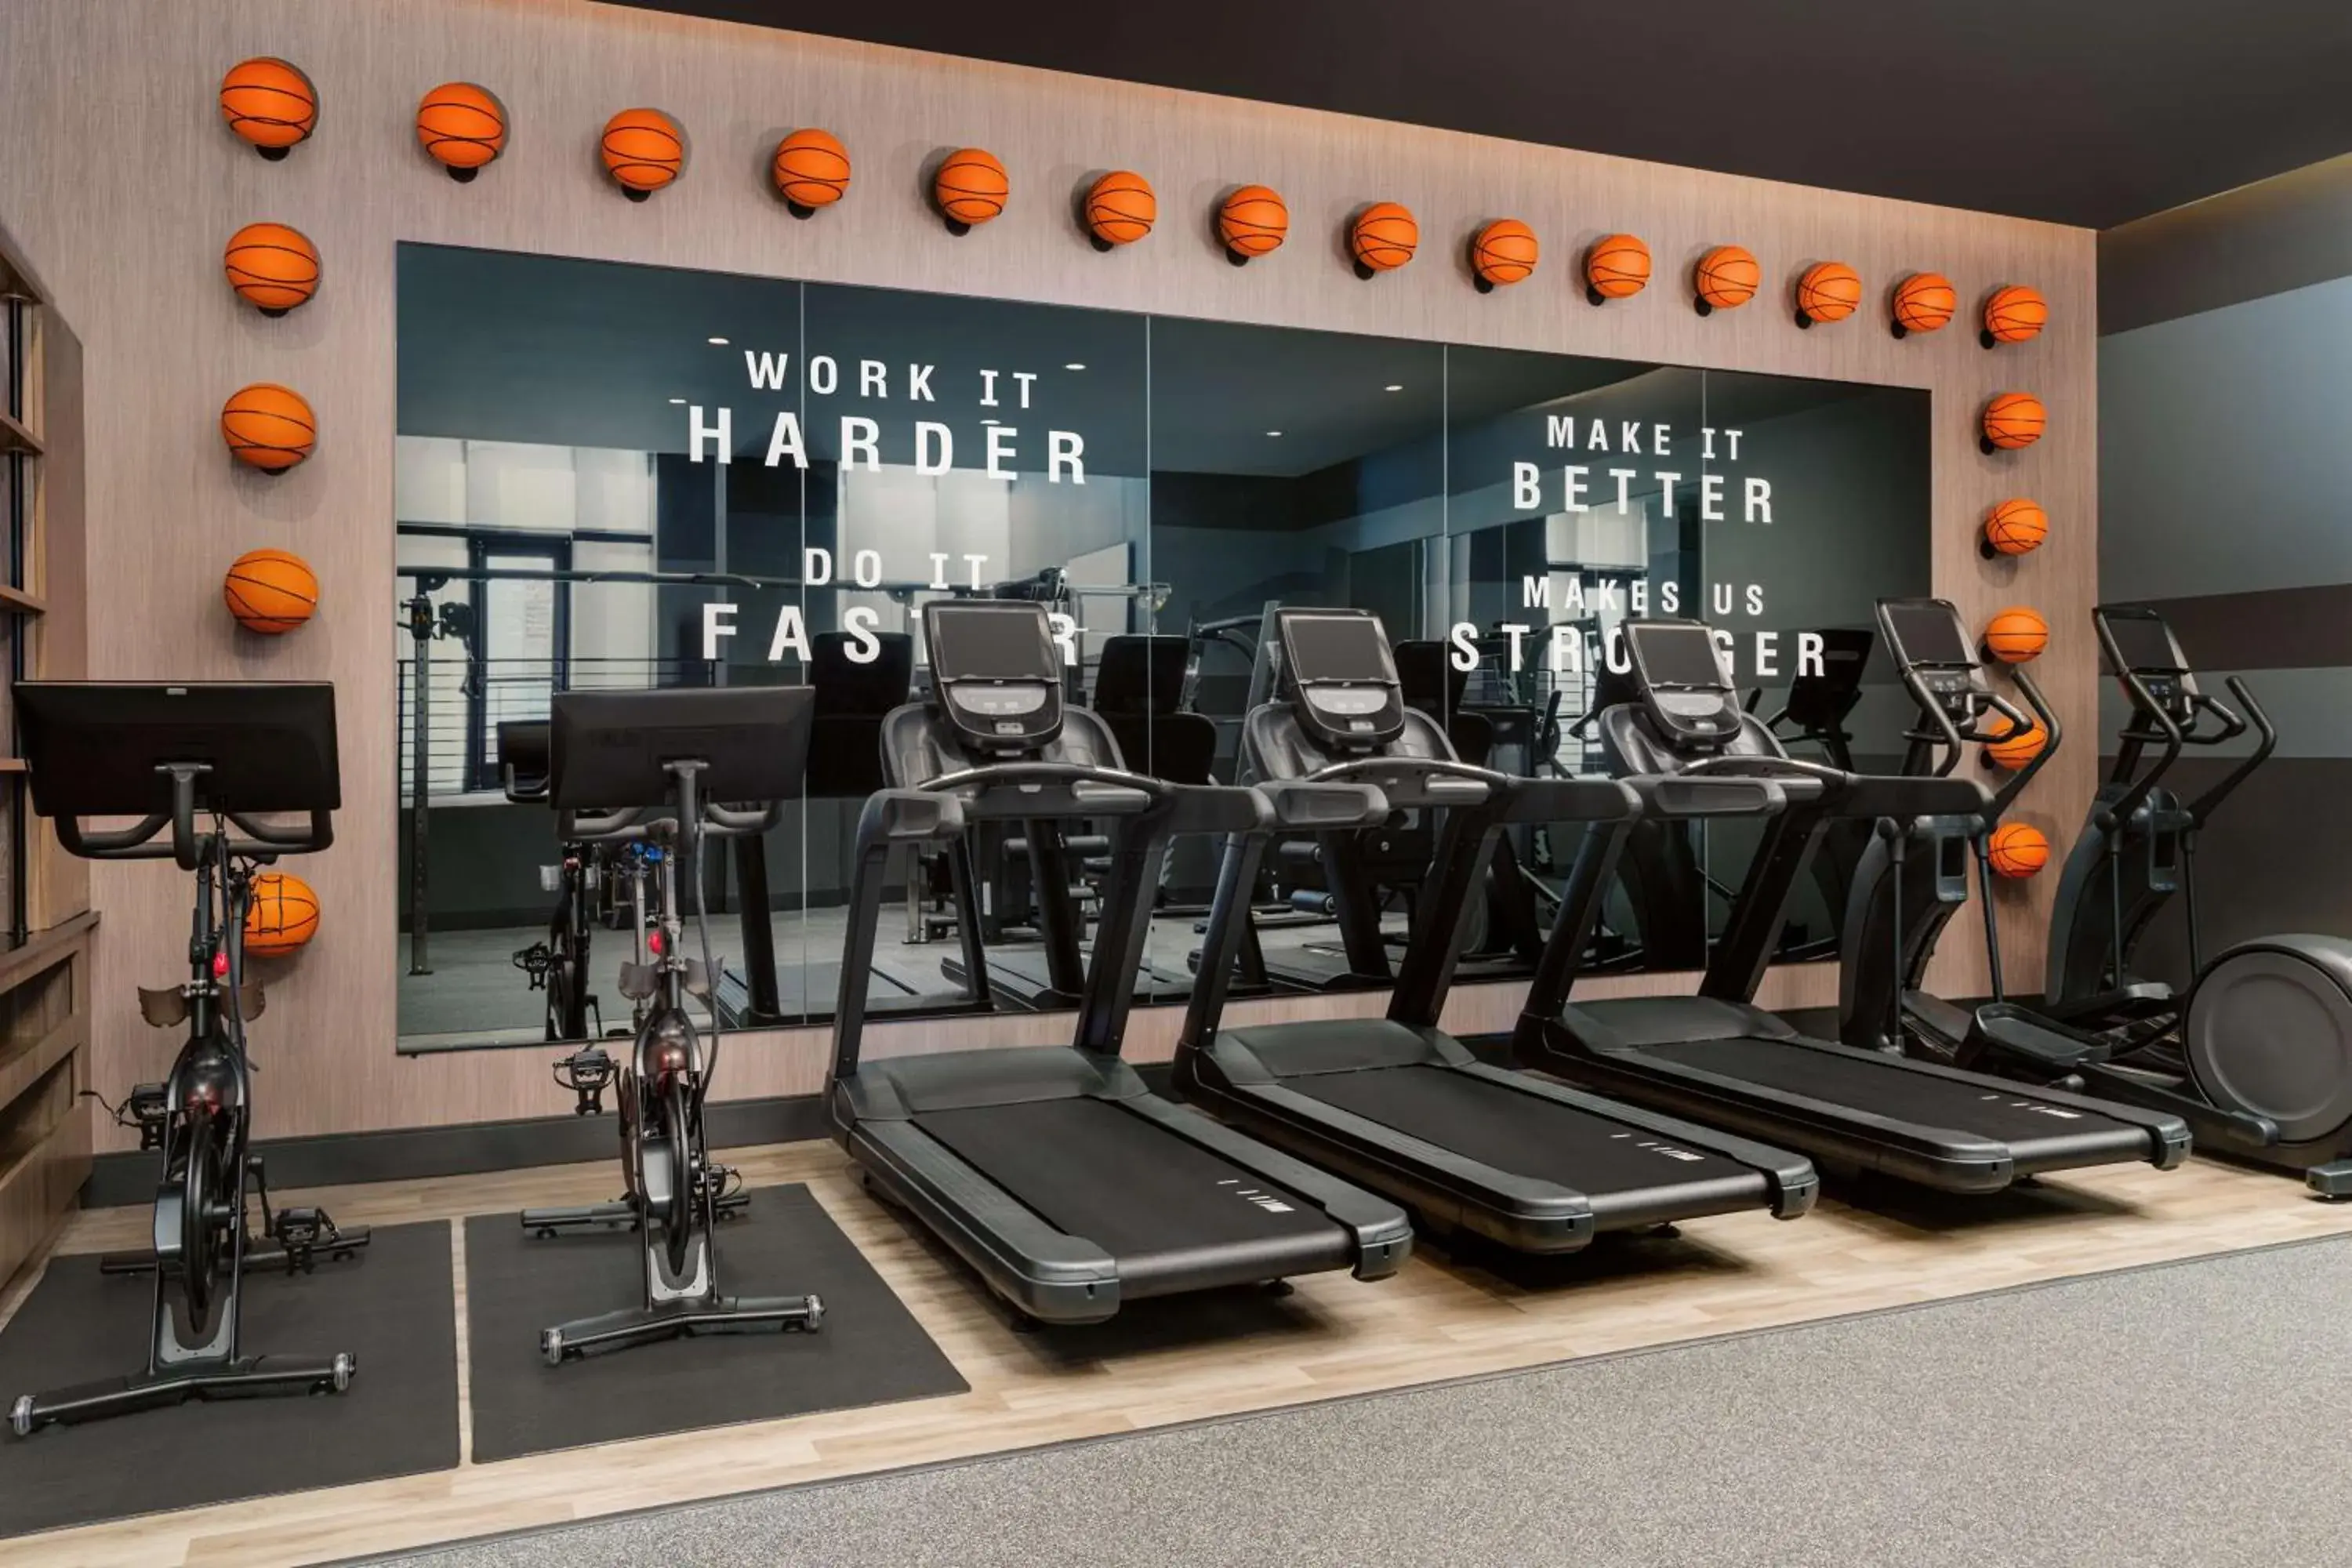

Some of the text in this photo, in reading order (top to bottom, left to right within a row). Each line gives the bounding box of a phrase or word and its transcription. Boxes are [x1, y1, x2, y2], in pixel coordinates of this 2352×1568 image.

[745, 350, 1037, 408] WORK IT
[689, 405, 1086, 485] HARDER
[1547, 416, 1743, 461] MAKE IT
[1514, 462, 1773, 524] BETTER
[805, 547, 988, 590] DO IT
[1523, 575, 1764, 616] MAKES US
[702, 602, 1078, 666] FASR
[1450, 622, 1825, 678] STROGER
